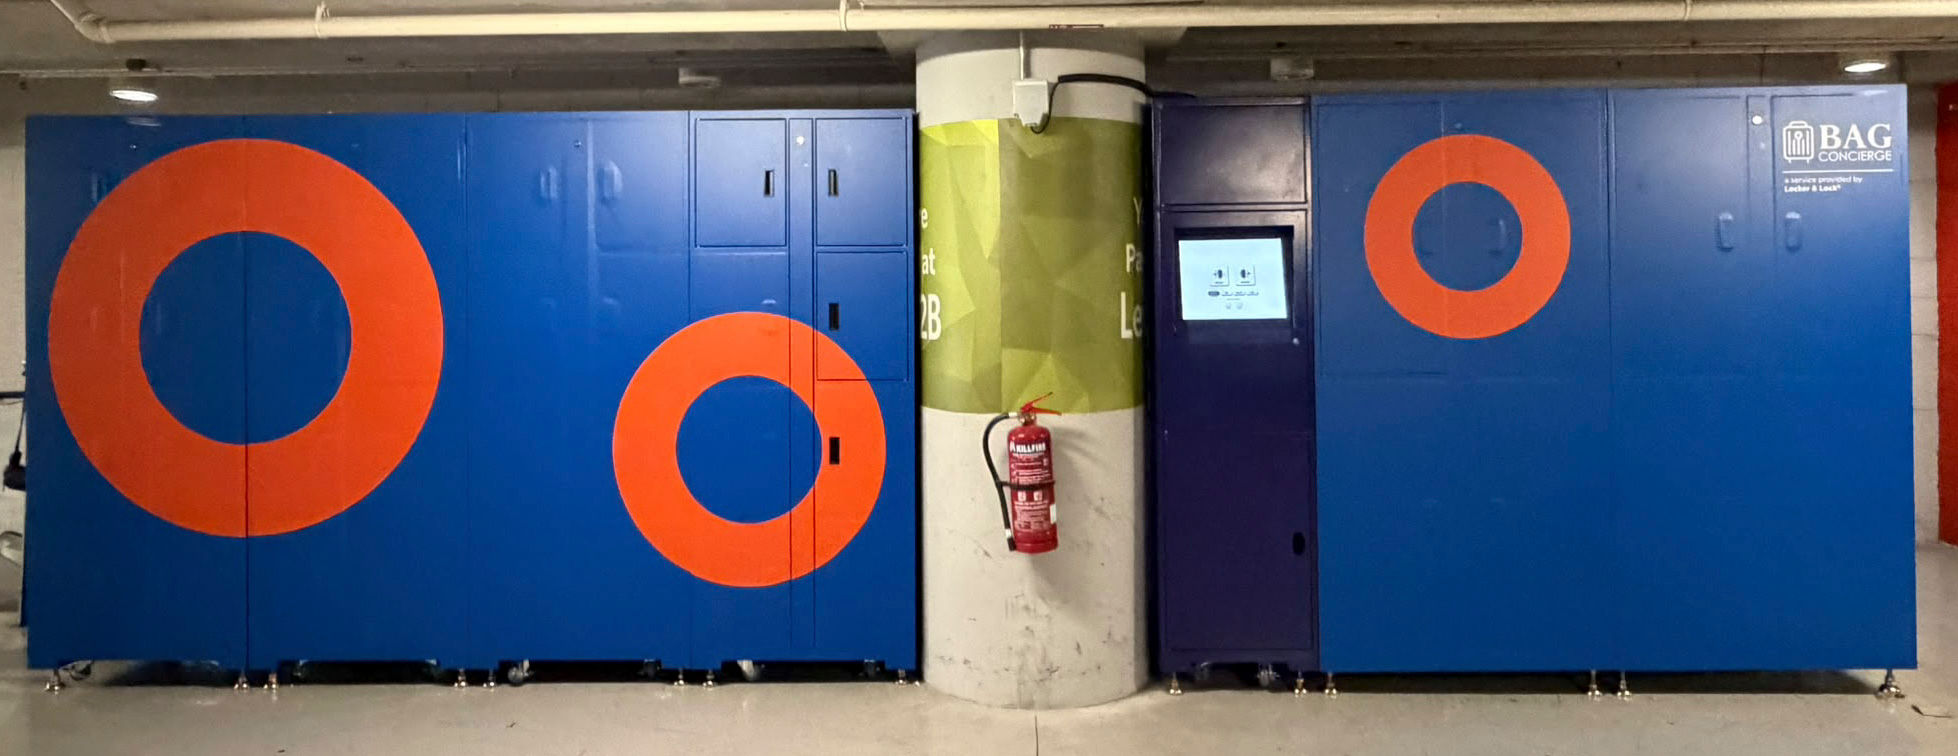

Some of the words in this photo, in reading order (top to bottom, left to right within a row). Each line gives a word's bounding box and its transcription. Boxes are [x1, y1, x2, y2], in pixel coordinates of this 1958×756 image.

[1820, 123, 1892, 149] BAG
[1818, 150, 1892, 162] CONCIERGE
[1818, 176, 1851, 185] provided
[1853, 176, 1863, 184] by
[1784, 185, 1810, 193] Locker
[1812, 184, 1817, 192] &
[921, 293, 941, 340] 2B
